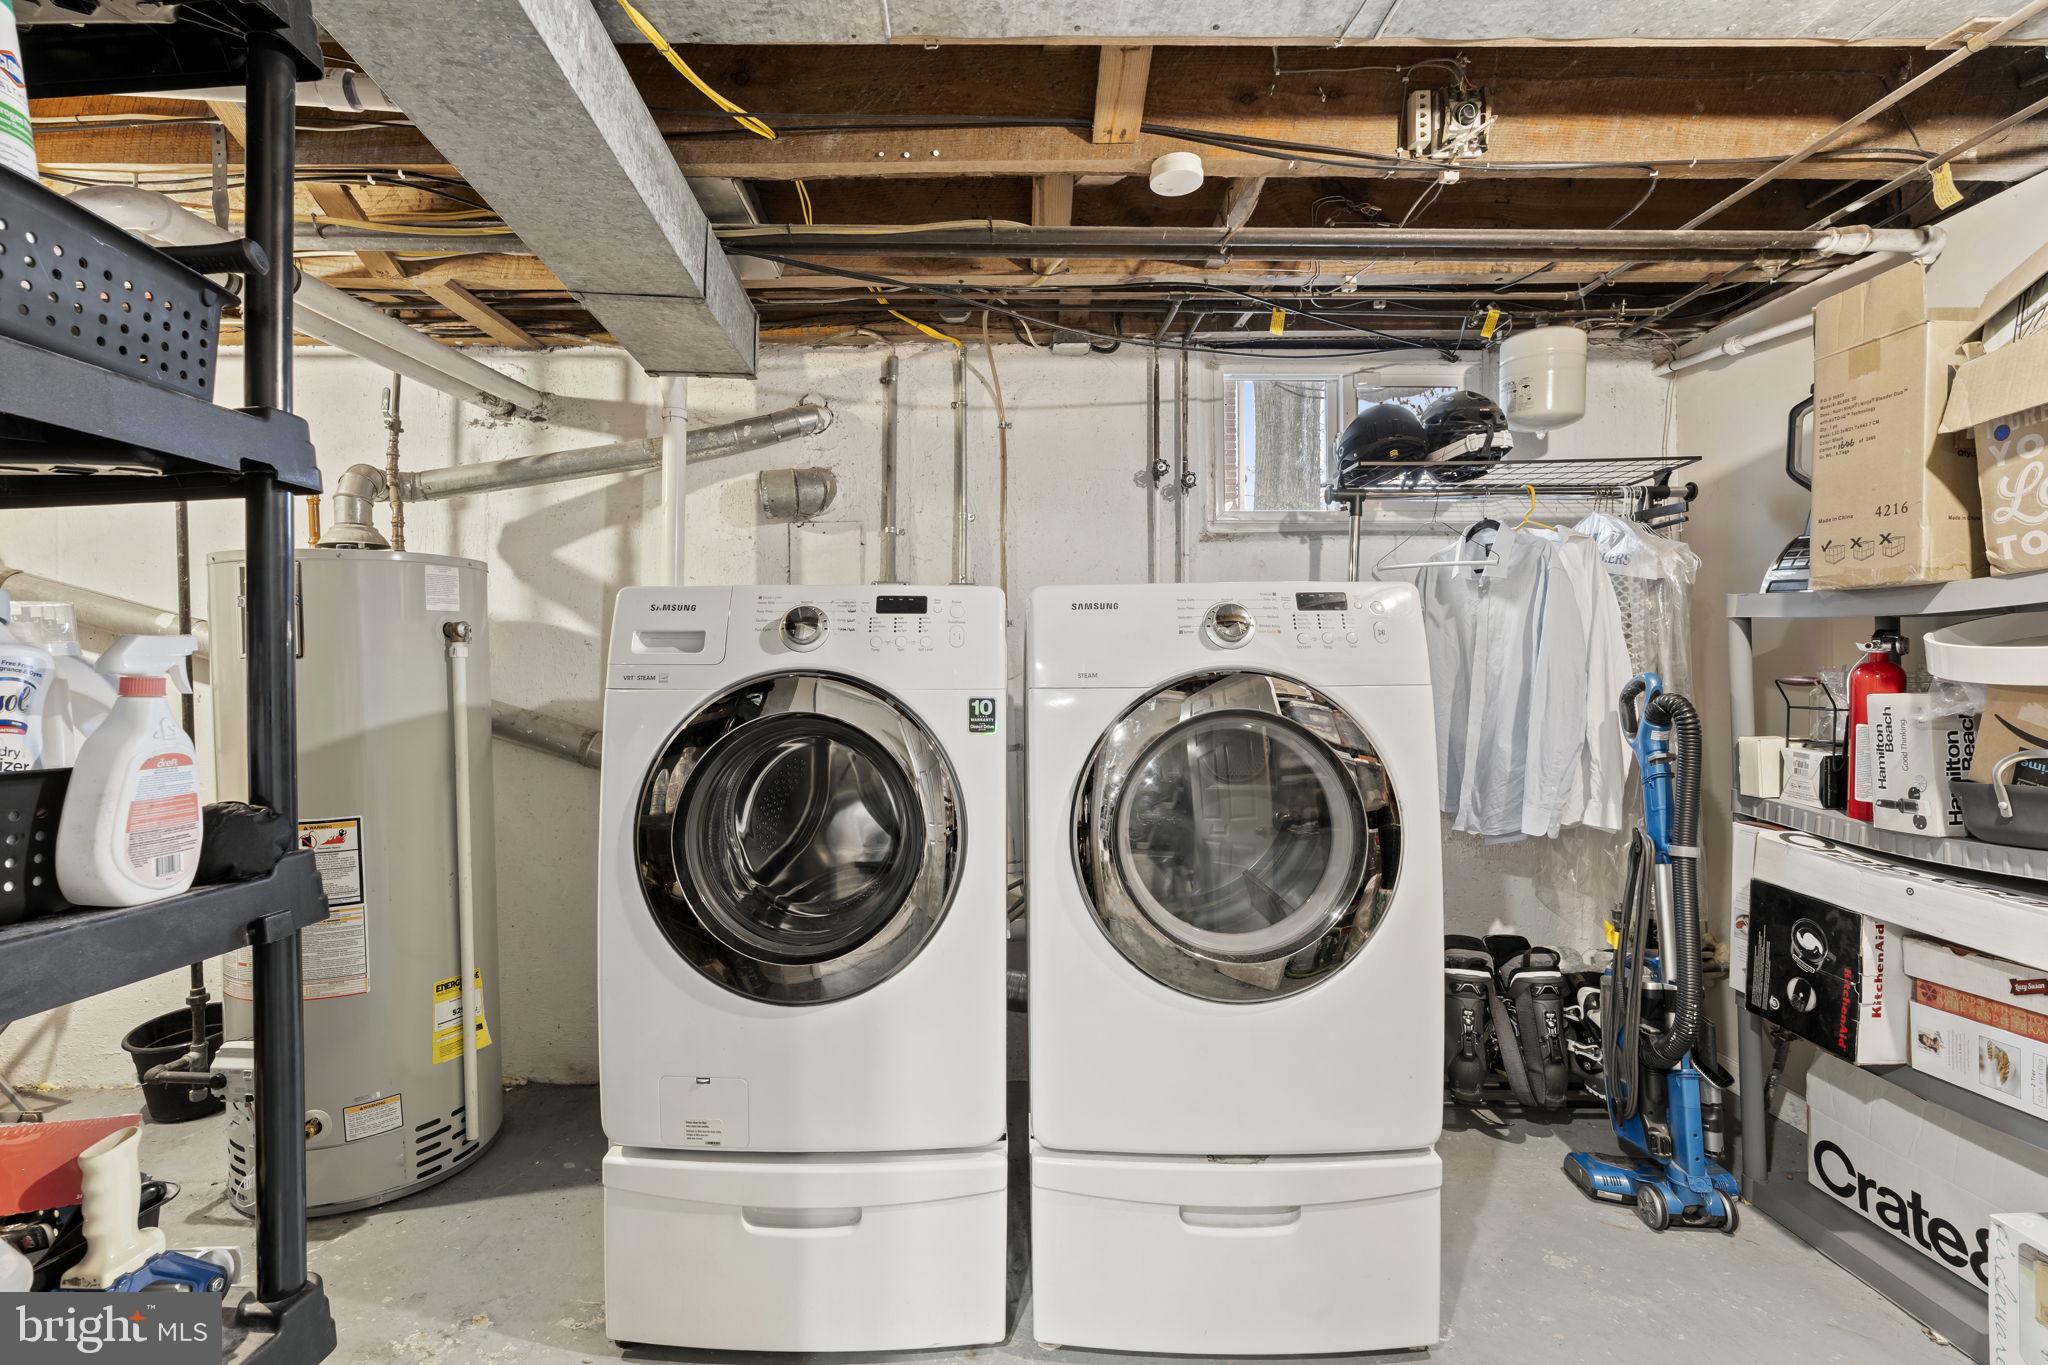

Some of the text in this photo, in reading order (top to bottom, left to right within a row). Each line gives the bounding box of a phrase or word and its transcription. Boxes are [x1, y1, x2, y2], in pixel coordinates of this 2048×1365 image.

[1875, 501, 1909, 518] 4216
[650, 603, 697, 612] SAMSUNG
[1071, 602, 1119, 611] SAMSUNG
[971, 699, 993, 716] 10
[1882, 706, 1894, 753] Beach
[1900, 719, 1909, 772] Good Thinking
[1876, 724, 1887, 790] Hamilton
[1872, 924, 1885, 1018] KitchenAid
[2027, 982, 2046, 990] Susan
[1838, 966, 1853, 1050] KitchenAid
